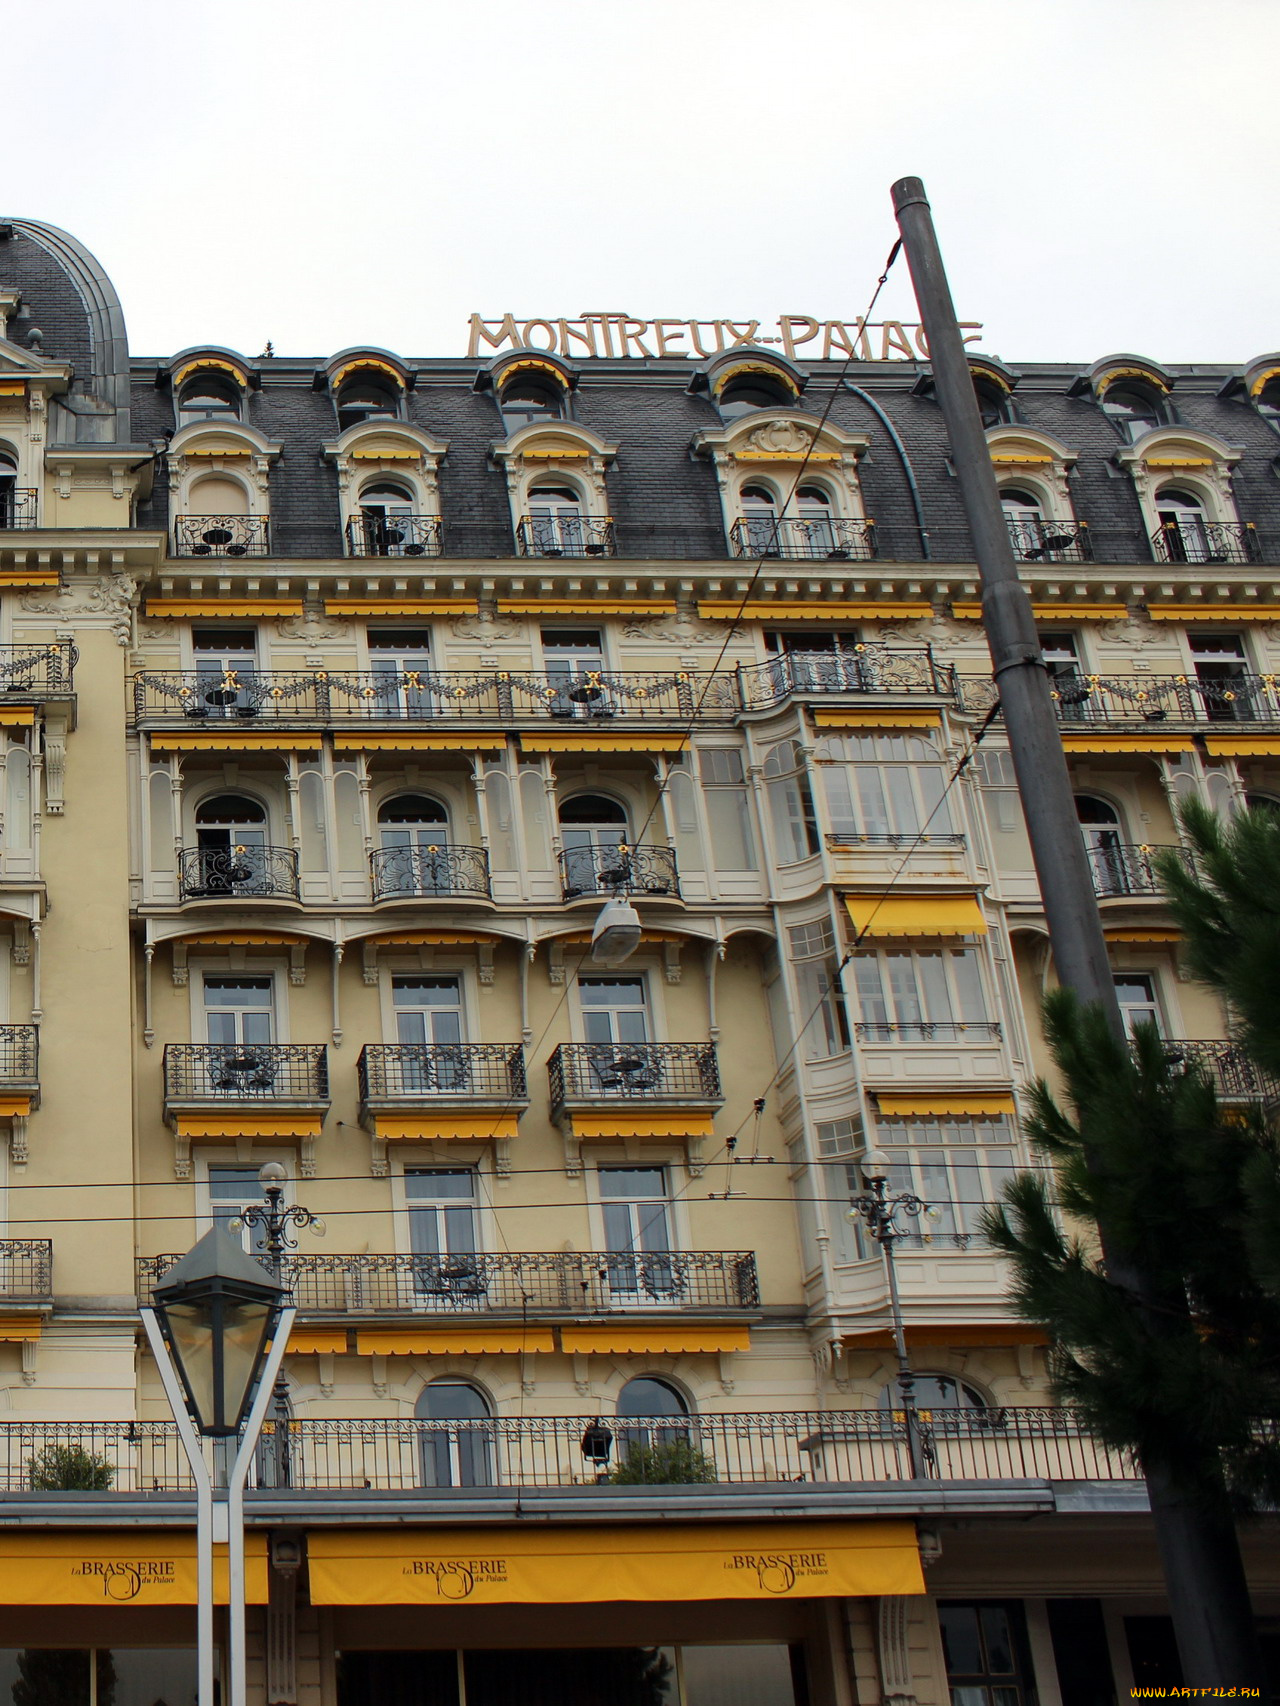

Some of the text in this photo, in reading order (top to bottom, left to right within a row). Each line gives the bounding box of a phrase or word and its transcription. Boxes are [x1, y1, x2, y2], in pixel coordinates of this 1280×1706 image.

[413, 1560, 507, 1575] BRASSERIE
[733, 1553, 827, 1568] BRASSERIE
[81, 1561, 175, 1576] BRASSERIE
